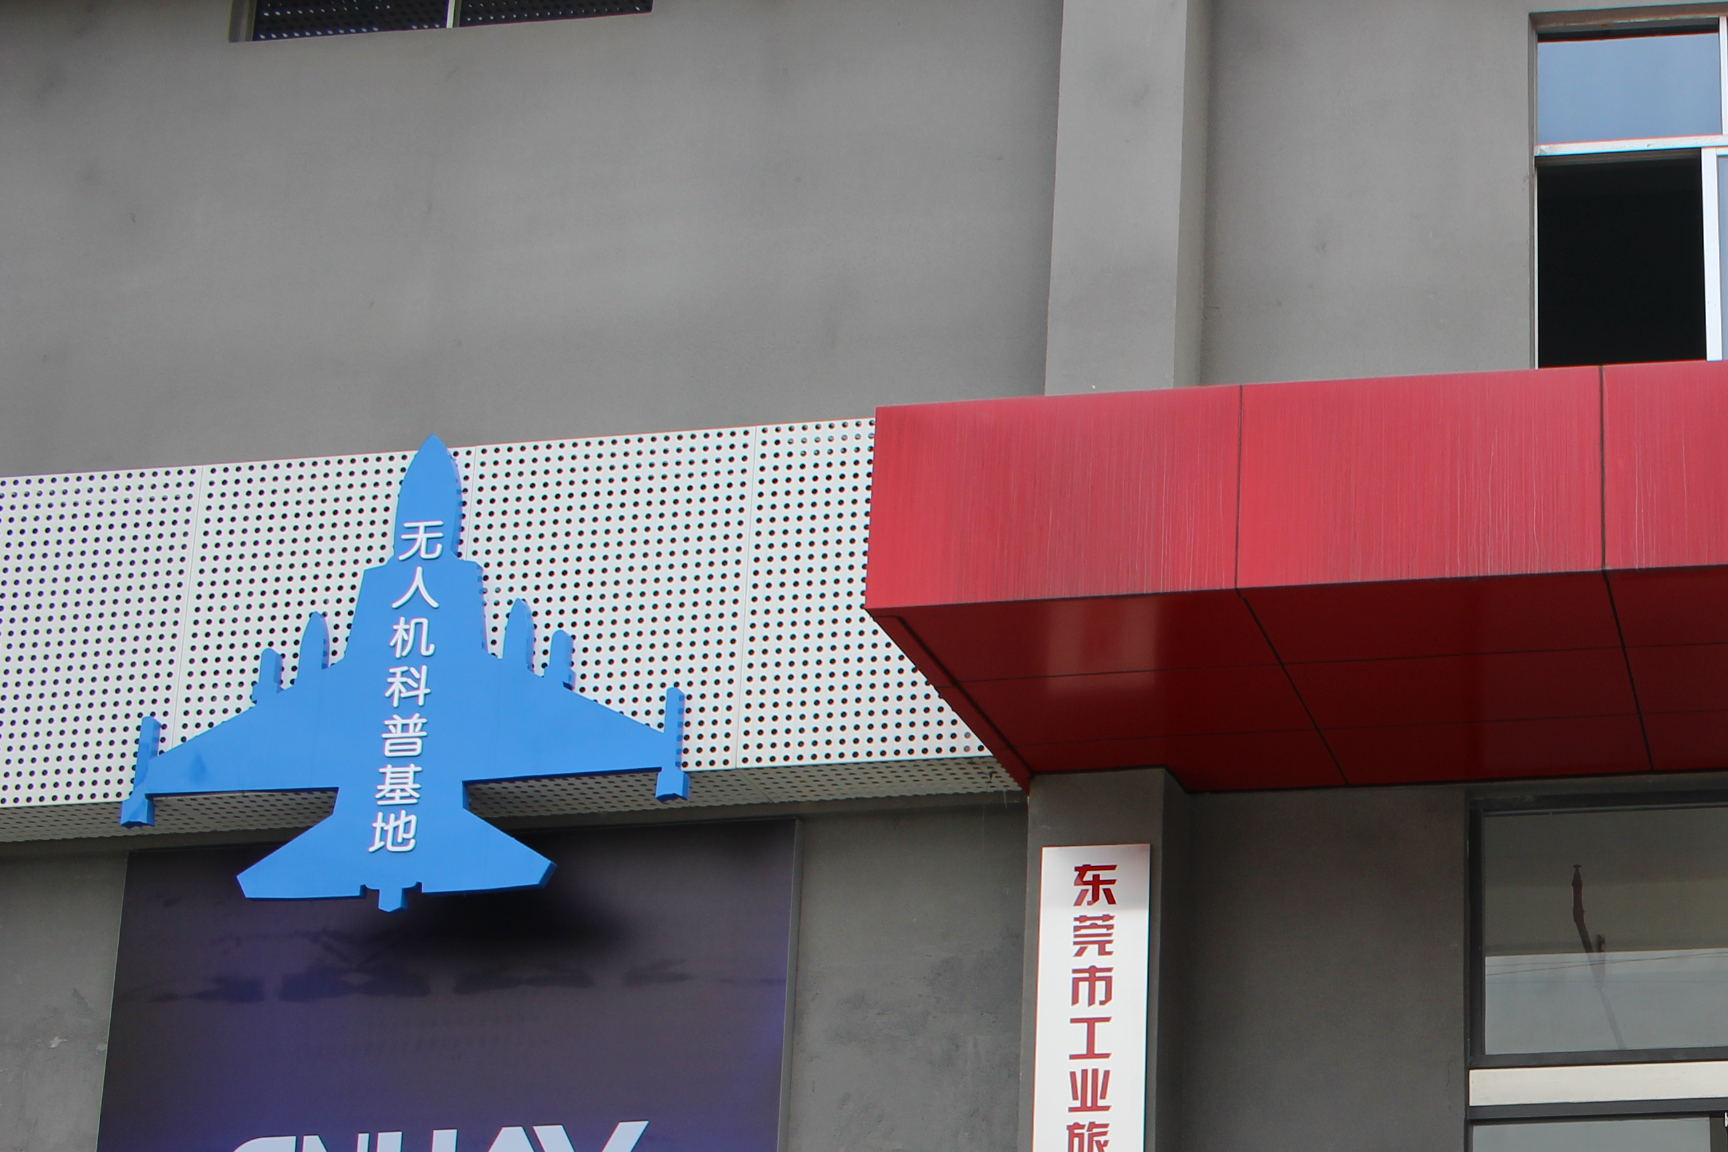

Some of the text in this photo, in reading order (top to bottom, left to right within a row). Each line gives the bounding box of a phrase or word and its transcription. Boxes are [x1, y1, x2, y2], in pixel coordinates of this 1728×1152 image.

[369, 520, 445, 853] 无人机科普基地
